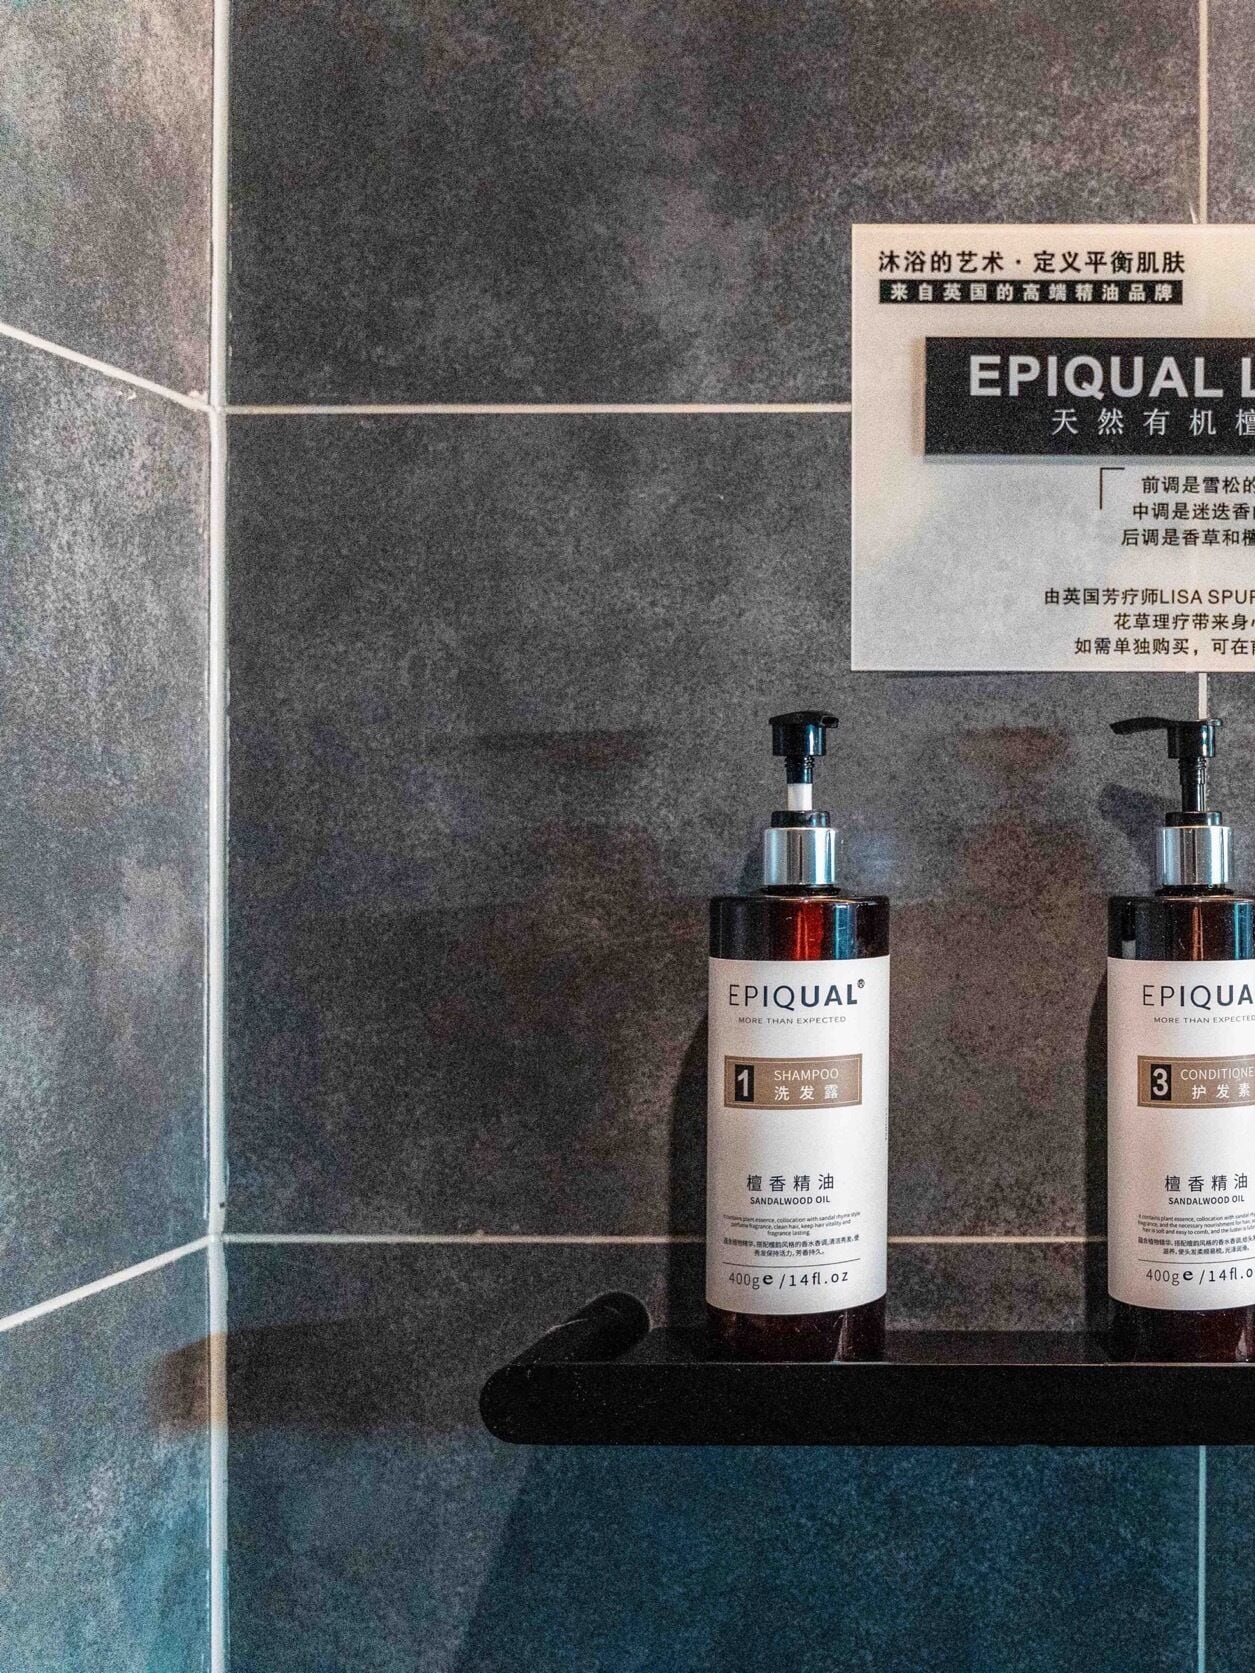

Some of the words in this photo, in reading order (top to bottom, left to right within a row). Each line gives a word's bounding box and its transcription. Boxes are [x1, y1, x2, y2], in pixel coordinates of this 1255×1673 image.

[890, 282, 1174, 303] 来自英国的高端精油品牌
[970, 356, 1223, 400] EPIQUAL
[738, 1017, 763, 1025] MORE
[767, 1017, 794, 1025] THAN
[796, 1016, 847, 1025] EXPECTED
[737, 1069, 749, 1097] 1
[774, 1068, 839, 1081] SHAMPOO
[1152, 1067, 1169, 1096] 3
[774, 1084, 840, 1101] 洗发露
[1191, 1082, 1251, 1100] 护发素
[746, 1172, 834, 1192] 檀香精油
[1165, 1172, 1248, 1192] 檀香精油
[750, 1196, 813, 1206] SANDALWOOD
[815, 1195, 831, 1204] OIL
[1168, 1197, 1229, 1206] SANDALWOOD
[1232, 1195, 1245, 1204] OIL
